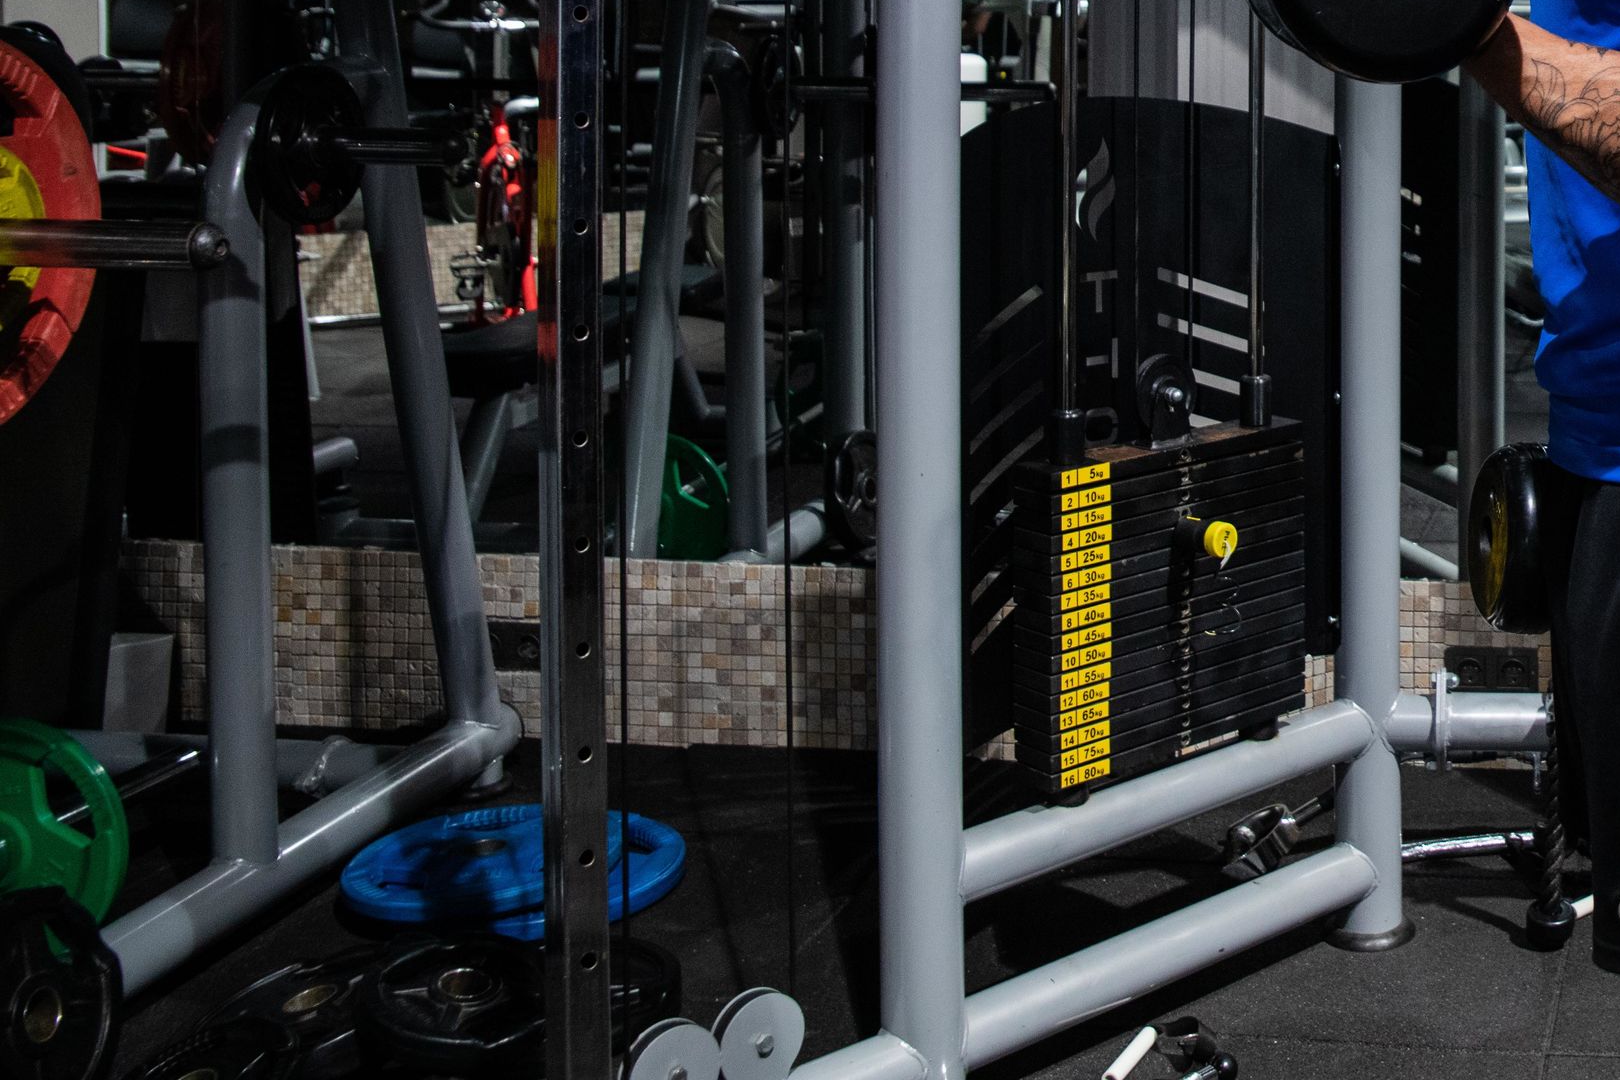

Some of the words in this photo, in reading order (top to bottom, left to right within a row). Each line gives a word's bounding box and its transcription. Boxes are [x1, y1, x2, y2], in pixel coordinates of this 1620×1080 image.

[1066, 474, 1071, 484] 1
[1089, 467, 1104, 480] 5kg
[1067, 497, 1073, 508] 2
[1085, 491, 1105, 504] 10kg
[1066, 517, 1073, 528] 3
[1085, 511, 1105, 523] 15kg
[1067, 537, 1074, 547] 4
[1085, 530, 1106, 544] 20kg
[1065, 557, 1072, 568] 5
[1083, 550, 1104, 564] 25kg
[1067, 578, 1073, 589] 6
[1085, 570, 1105, 584] 30kg
[1065, 597, 1071, 607] 7
[1083, 589, 1104, 603] 35kg
[1066, 617, 1073, 628] 8
[1084, 609, 1105, 622] 40kg
[1066, 638, 1073, 648] 9
[1084, 629, 1105, 642] 45kg
[1065, 656, 1076, 668] 10
[1085, 649, 1106, 662] 50kg
[1064, 677, 1074, 688] 11
[1084, 670, 1105, 683] 55kg
[1063, 696, 1074, 707] 12
[1082, 688, 1103, 702] 60kg
[1062, 715, 1073, 727] 13
[1082, 707, 1103, 721] 65kg
[1064, 735, 1075, 747] 14
[1084, 727, 1104, 740] 70kg
[1064, 754, 1075, 766] 15
[1084, 746, 1104, 759] 75kg
[1064, 774, 1075, 786] 16
[1084, 766, 1105, 780] 80kg
